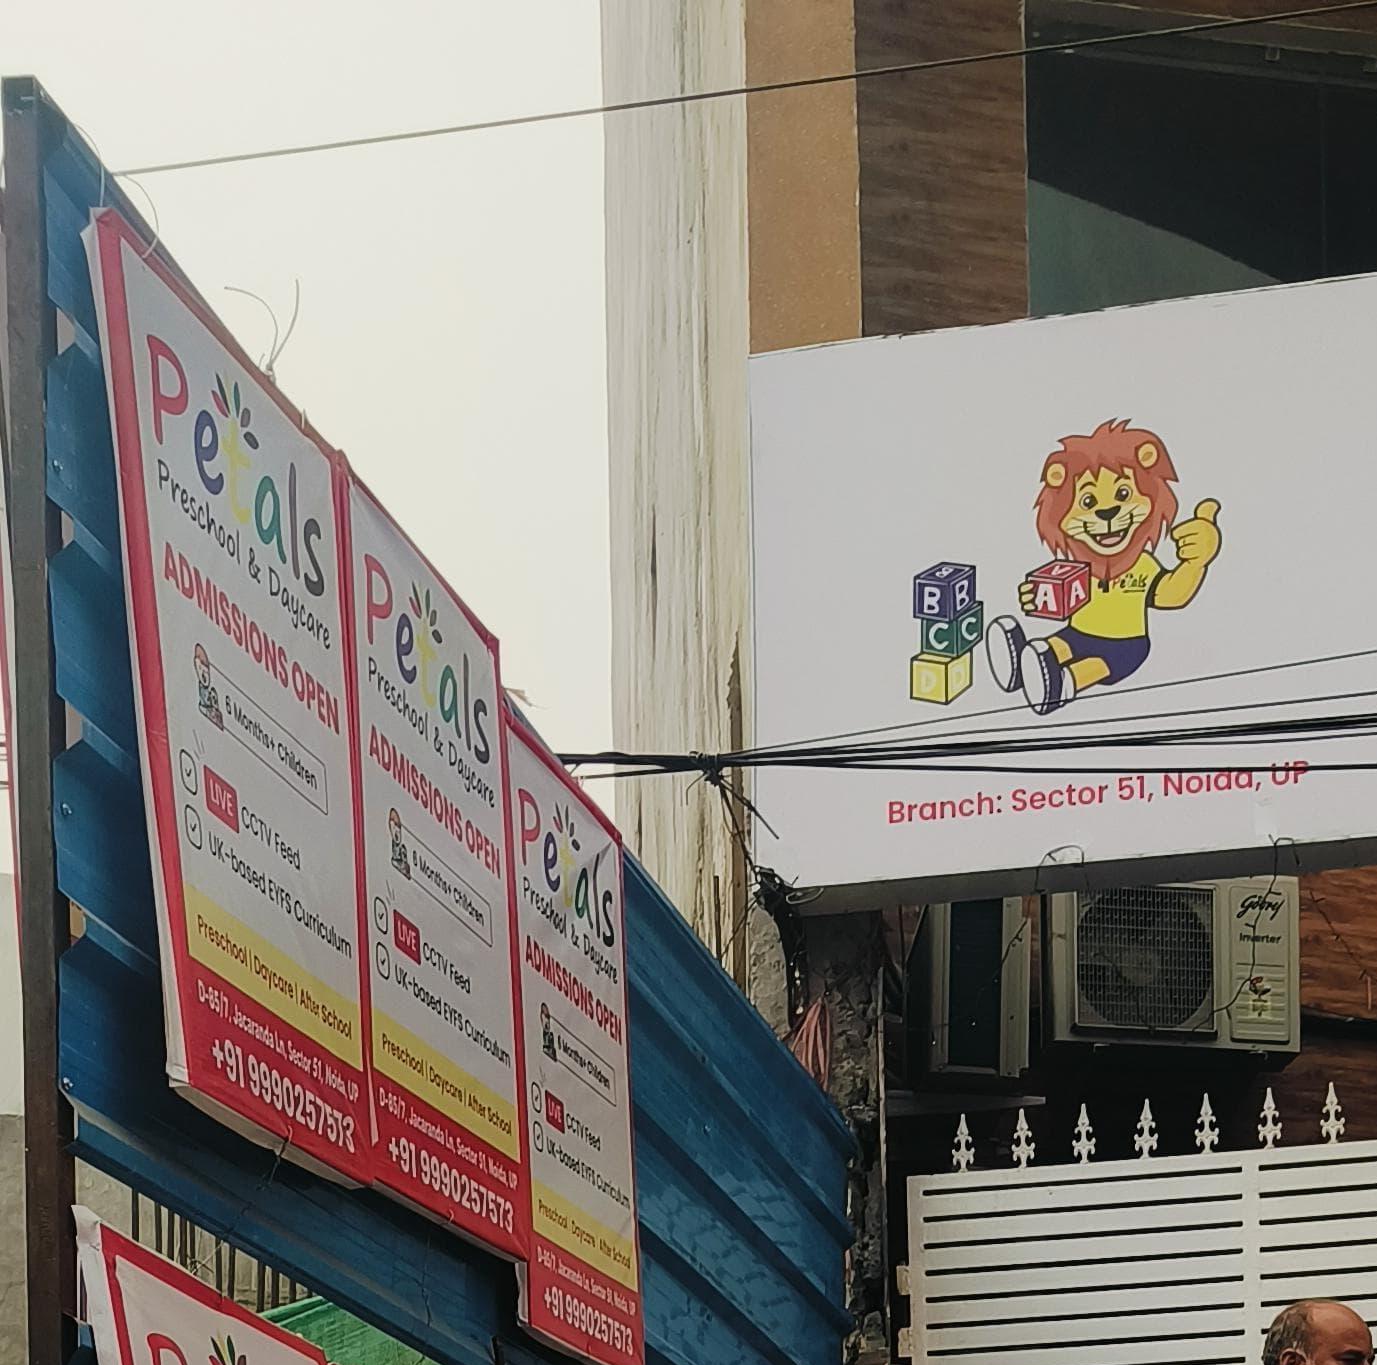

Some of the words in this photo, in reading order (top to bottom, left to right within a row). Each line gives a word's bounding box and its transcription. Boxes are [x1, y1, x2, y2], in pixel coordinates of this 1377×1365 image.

[147, 334, 325, 596] Petals
[158, 459, 240, 564] Preschool
[248, 548, 261, 584] &
[268, 566, 331, 650] Daycare
[923, 586, 941, 614] B
[955, 580, 970, 610] B
[1036, 583, 1057, 611] A
[1069, 580, 1087, 607] A
[164, 541, 289, 688] ADMISSIONS
[292, 661, 340, 735] OPEN
[364, 553, 490, 765] Petals
[929, 622, 948, 649] C
[961, 617, 978, 641] C
[225, 695, 232, 715] 6
[233, 702, 275, 751] Months+
[278, 742, 318, 790] Children
[369, 656, 428, 742] Preschool
[433, 726, 444, 757] &
[448, 740, 495, 808] Daycare
[209, 777, 234, 817] LIVE
[241, 806, 272, 847] CCTV
[274, 832, 301, 870] Feed
[369, 724, 463, 843] ADMISSIONS
[465, 819, 501, 880] OPEN
[888, 792, 1002, 824] Branch:
[1011, 783, 1108, 812] Sector
[1118, 776, 1154, 803] 51,
[1163, 767, 1260, 796] Noida,
[1271, 761, 1309, 786] UP
[208, 831, 266, 895] UK-based
[268, 879, 292, 915] EYFS
[293, 900, 352, 959] Curriculum
[518, 788, 615, 948] Petals
[523, 876, 567, 939] Preschool
[197, 914, 249, 967] Preschool
[253, 955, 294, 999] Daycare
[321, 1006, 352, 1040] School
[398, 919, 417, 951] LIVE
[422, 942, 449, 976] CCTV
[449, 963, 471, 994] Feed
[525, 935, 594, 1021] ADMISSIONS
[595, 998, 622, 1046] OPEN
[382, 1032, 425, 1077] Preschool
[394, 963, 442, 1016] UK-based
[464, 1019, 511, 1069] Curriculum
[211, 1038, 245, 1088] +91
[247, 1053, 356, 1154] 9990257573
[388, 1136, 417, 1178] +91
[420, 1149, 514, 1235] 9990257573
[544, 1285, 564, 1320] +91
[565, 1294, 634, 1356] 9990257573
